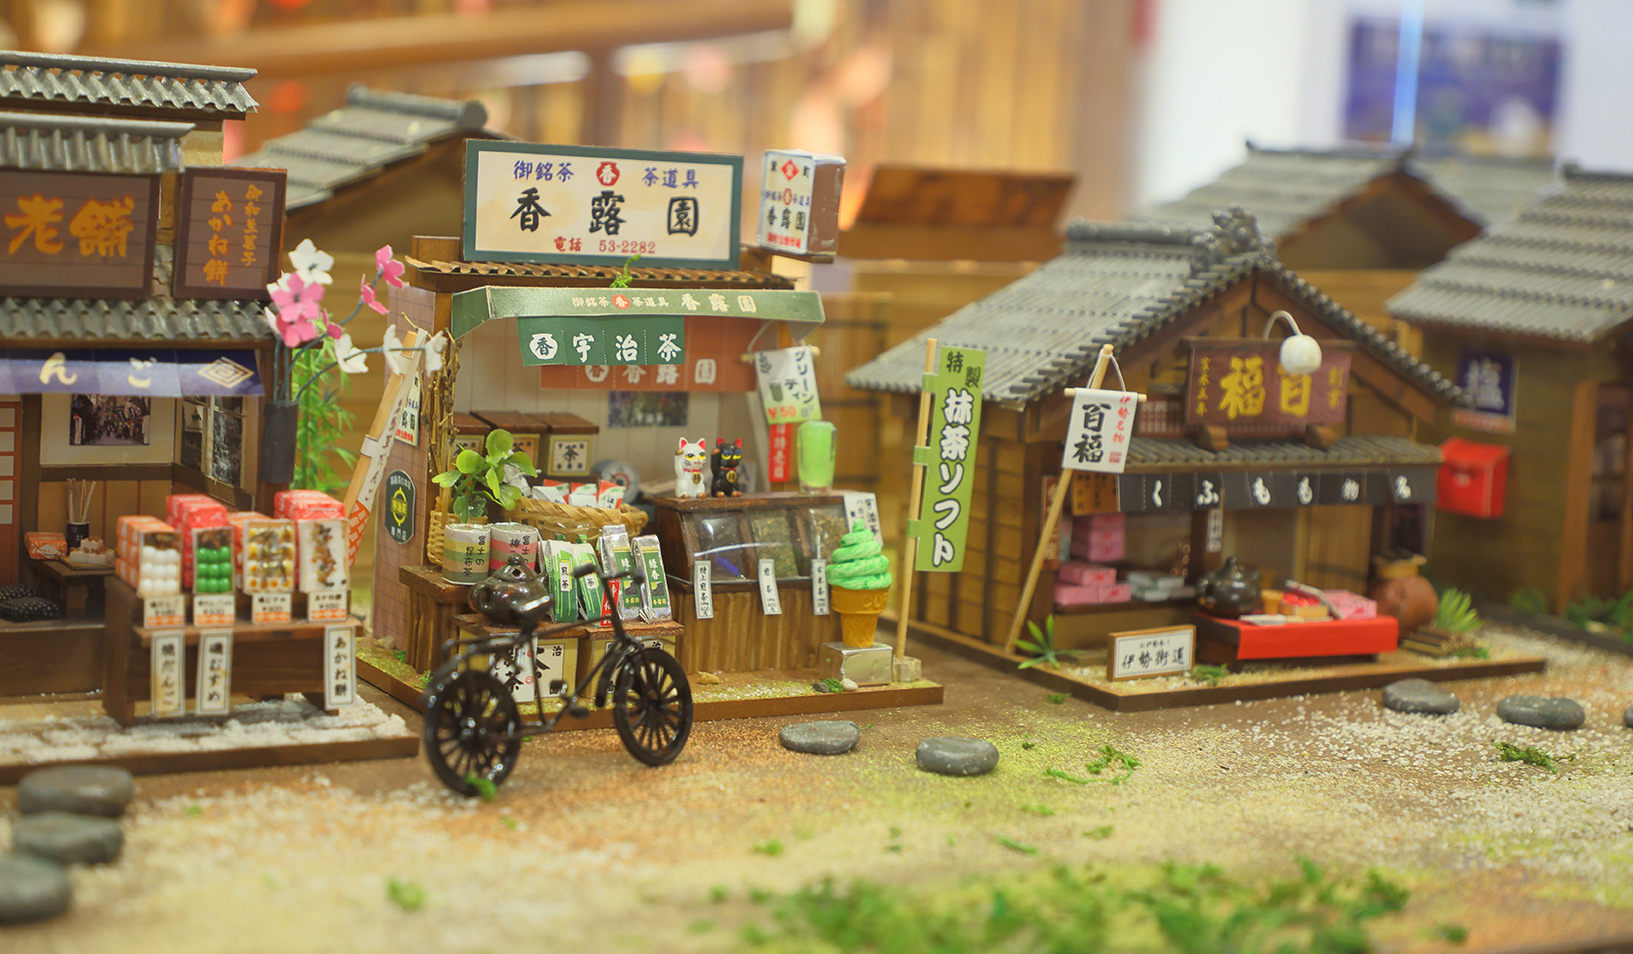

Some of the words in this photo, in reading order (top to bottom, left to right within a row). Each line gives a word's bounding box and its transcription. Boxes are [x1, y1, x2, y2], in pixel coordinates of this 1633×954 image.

[513, 160, 575, 182] 御銘茶
[642, 167, 699, 189] 茶道具
[510, 187, 700, 238] 香露園
[767, 206, 806, 231] 香露園
[553, 236, 582, 252] 電話
[598, 239, 656, 254] 53-2282
[571, 296, 610, 308] 御銘茶
[632, 297, 669, 308] 茶道具
[681, 292, 757, 313] 香露園
[572, 333, 683, 363] 宇治茶
[946, 350, 981, 389] 特製
[1072, 403, 1111, 463] 百福
[932, 388, 975, 568] 抹茶ソフト
[561, 566, 569, 589] 煎茶
